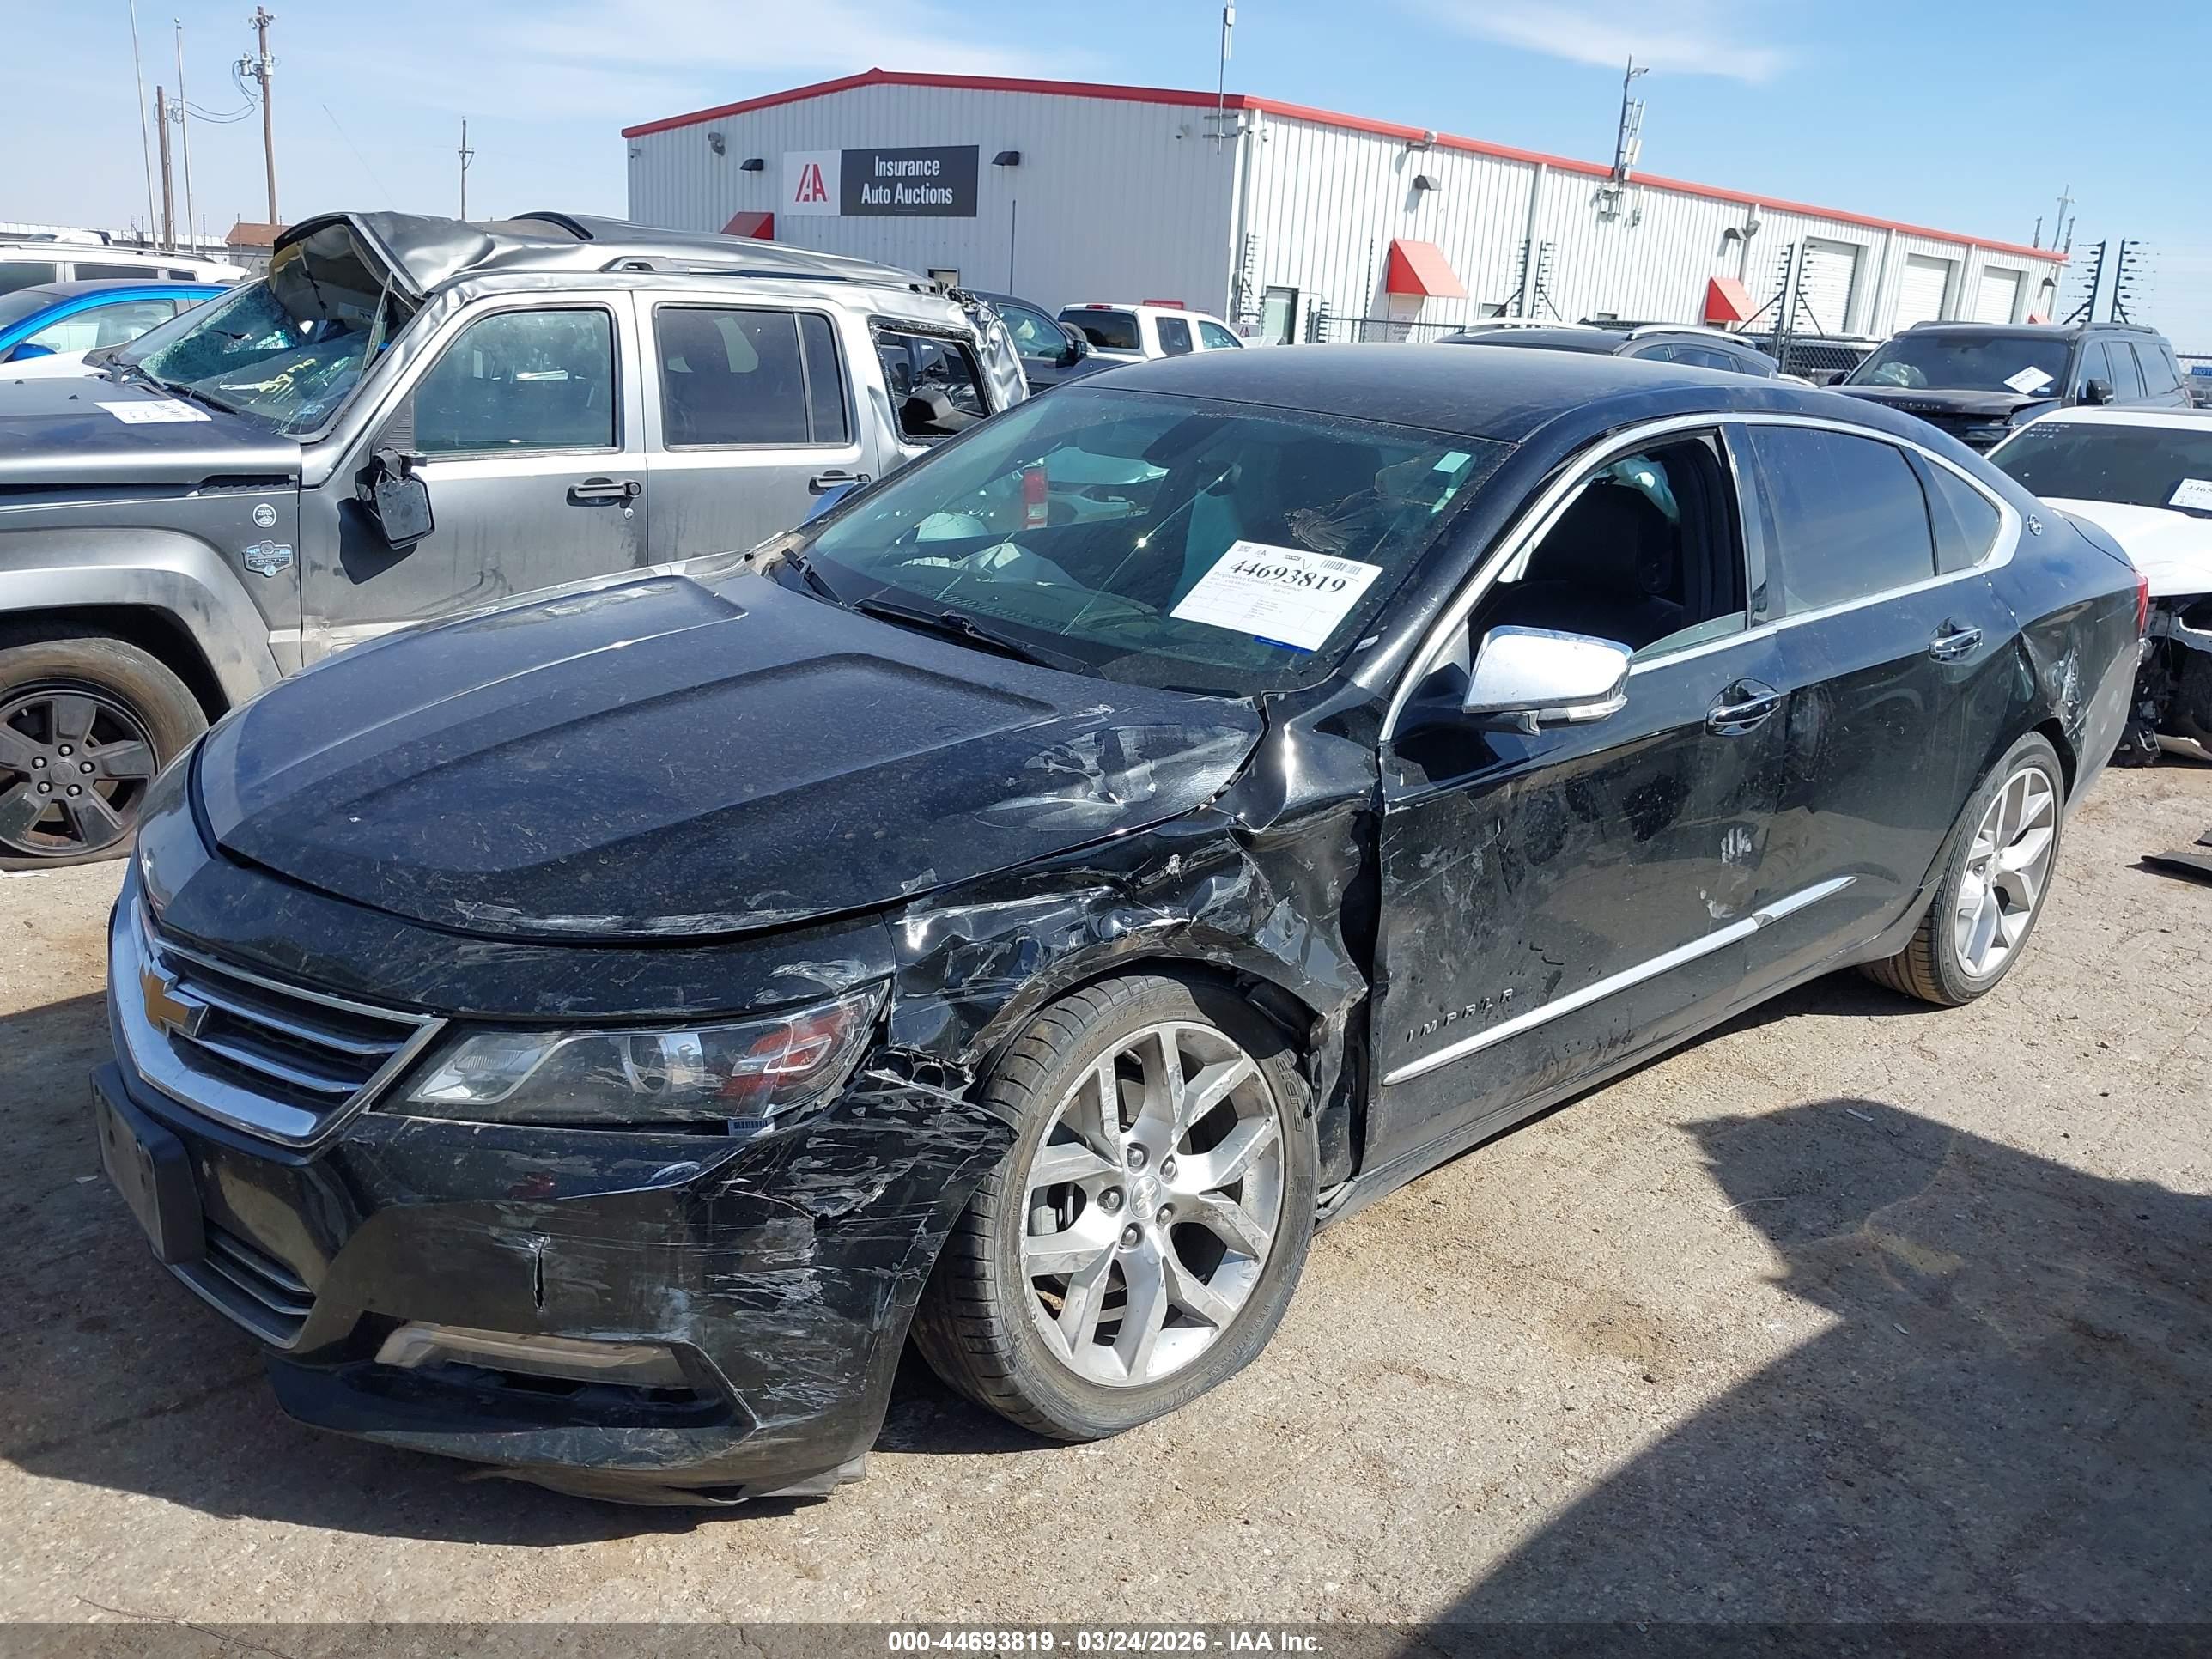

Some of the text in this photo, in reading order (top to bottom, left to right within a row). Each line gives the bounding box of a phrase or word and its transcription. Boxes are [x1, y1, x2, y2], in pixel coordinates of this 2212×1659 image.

[875, 155, 940, 177] Insurance
[861, 181, 953, 204] Auto Auctions
[1229, 560, 1347, 593] 44693819
